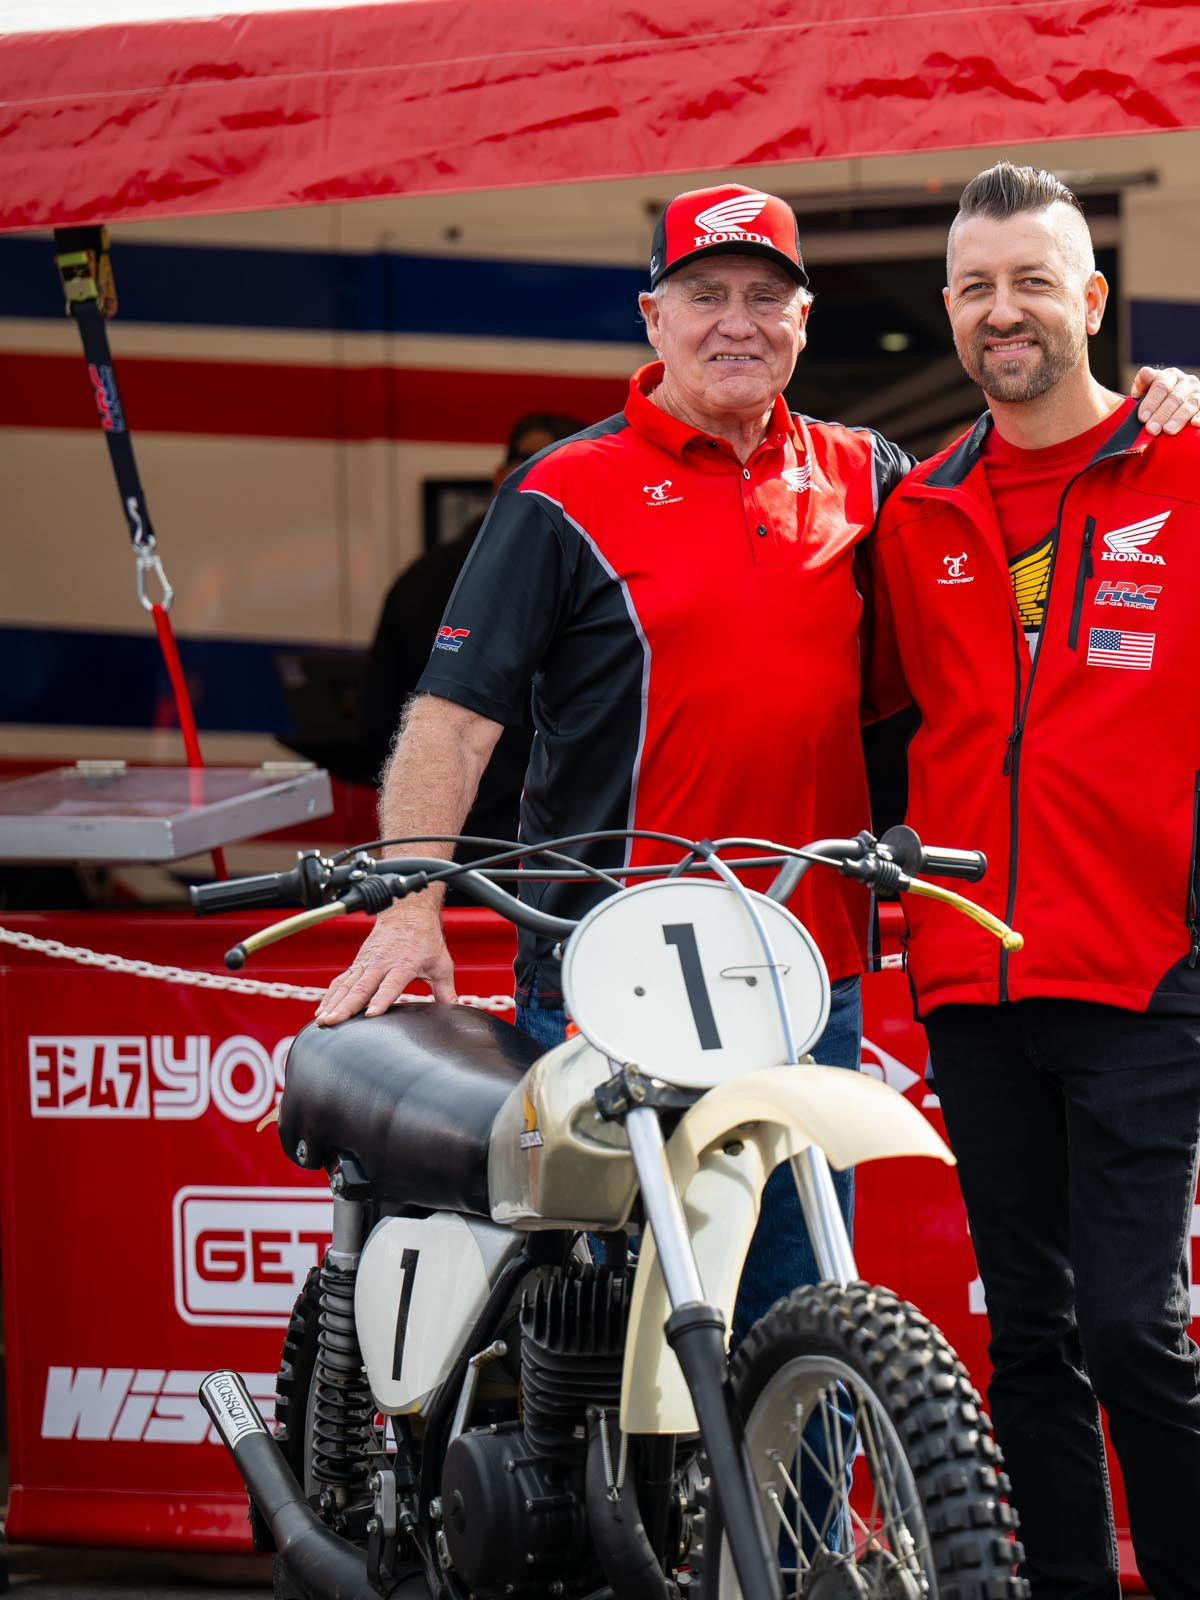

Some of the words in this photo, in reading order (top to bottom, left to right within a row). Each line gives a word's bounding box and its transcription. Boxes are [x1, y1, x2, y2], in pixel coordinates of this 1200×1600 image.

[694, 232, 775, 248] HONDA
[1101, 551, 1167, 565] HONDA
[1095, 581, 1163, 605] HRC
[661, 922, 724, 1051] 1
[391, 1248, 420, 1382] 1
